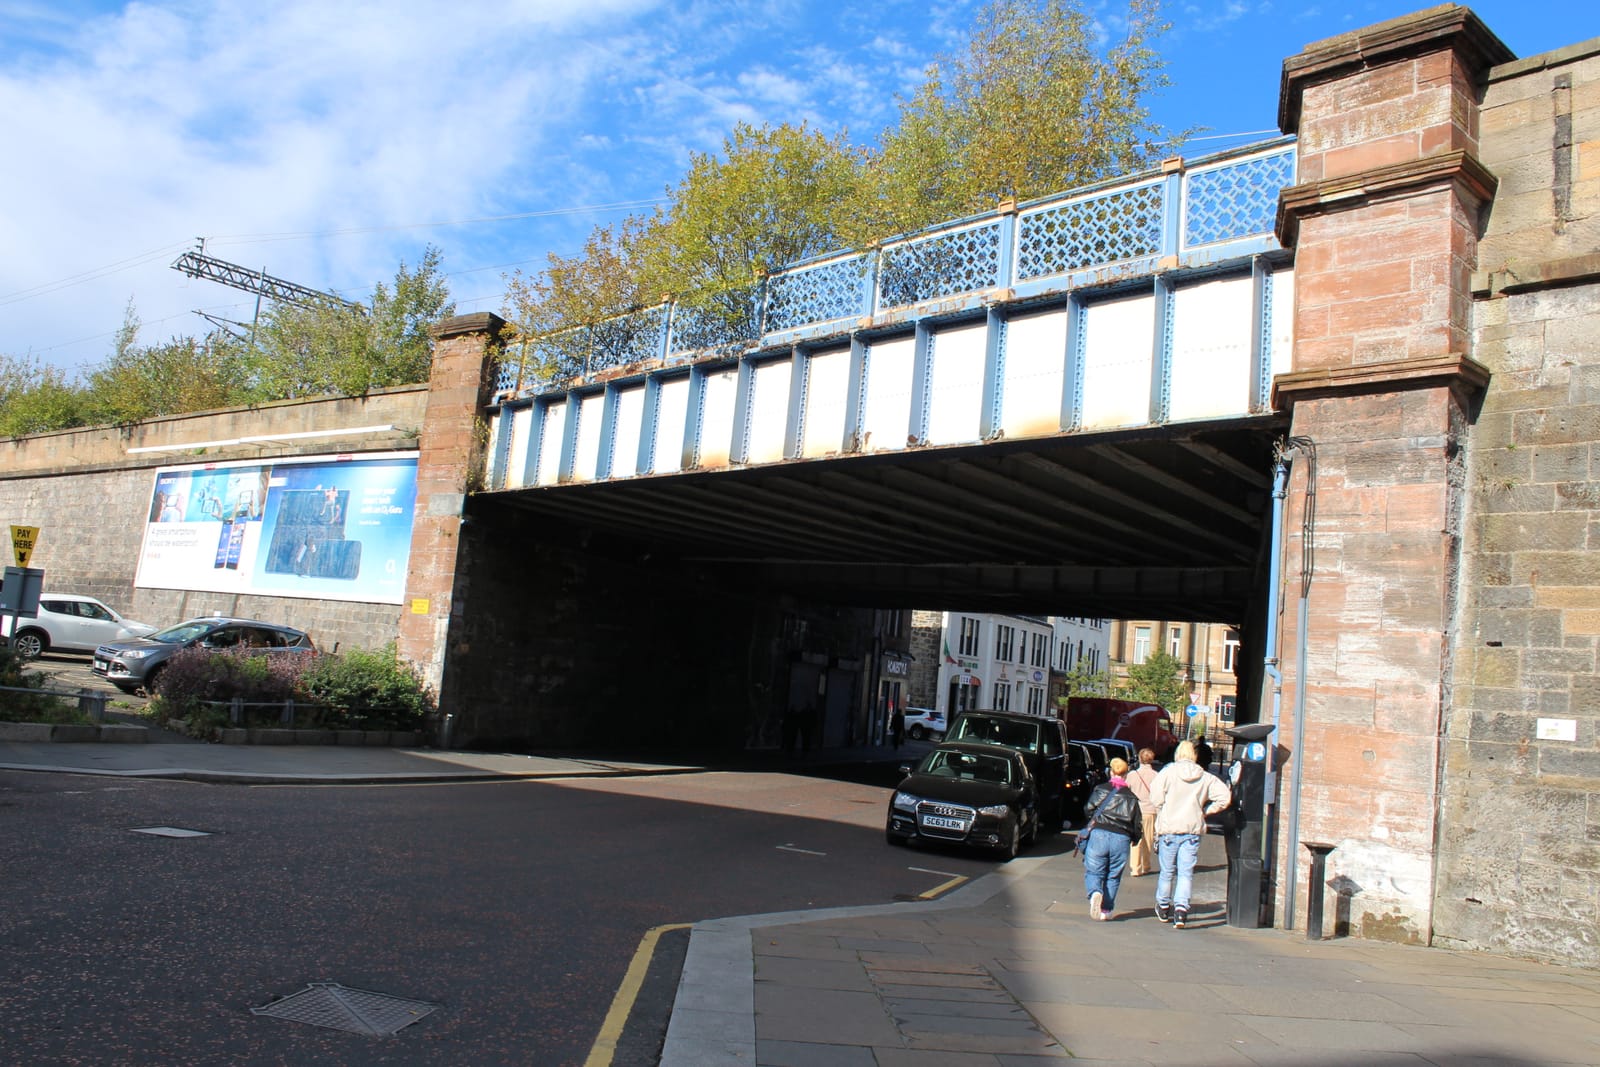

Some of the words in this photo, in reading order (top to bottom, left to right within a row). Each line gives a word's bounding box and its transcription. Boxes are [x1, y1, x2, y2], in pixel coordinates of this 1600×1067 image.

[17, 529, 31, 538] PAY
[15, 540, 32, 549] HERE
[926, 817, 946, 826] SC63
[946, 820, 961, 828] LRK
